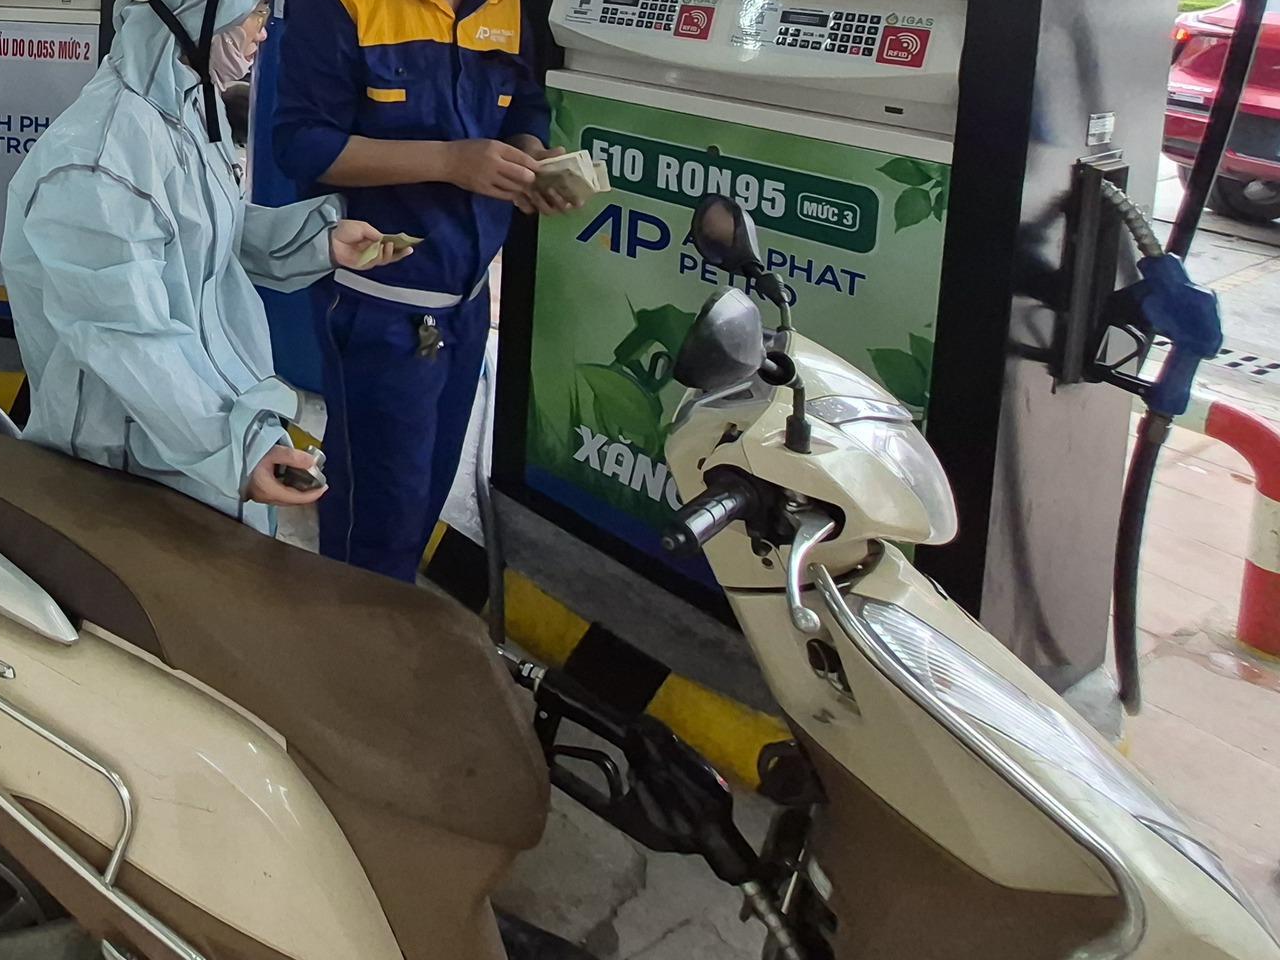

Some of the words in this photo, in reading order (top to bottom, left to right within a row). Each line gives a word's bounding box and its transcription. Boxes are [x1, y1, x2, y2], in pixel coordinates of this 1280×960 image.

[901, 15, 934, 27] IGAS
[12, 38, 24, 57] DO
[28, 39, 55, 60] 0,05S
[58, 37, 80, 60] MỨC
[84, 42, 90, 60] 2
[887, 50, 908, 58] RFID
[20, 115, 49, 133] PH
[657, 154, 786, 218] RON95
[803, 200, 838, 222] MỨC
[842, 211, 853, 225] 3
[576, 203, 671, 259] AP
[767, 248, 866, 297] PHAT
